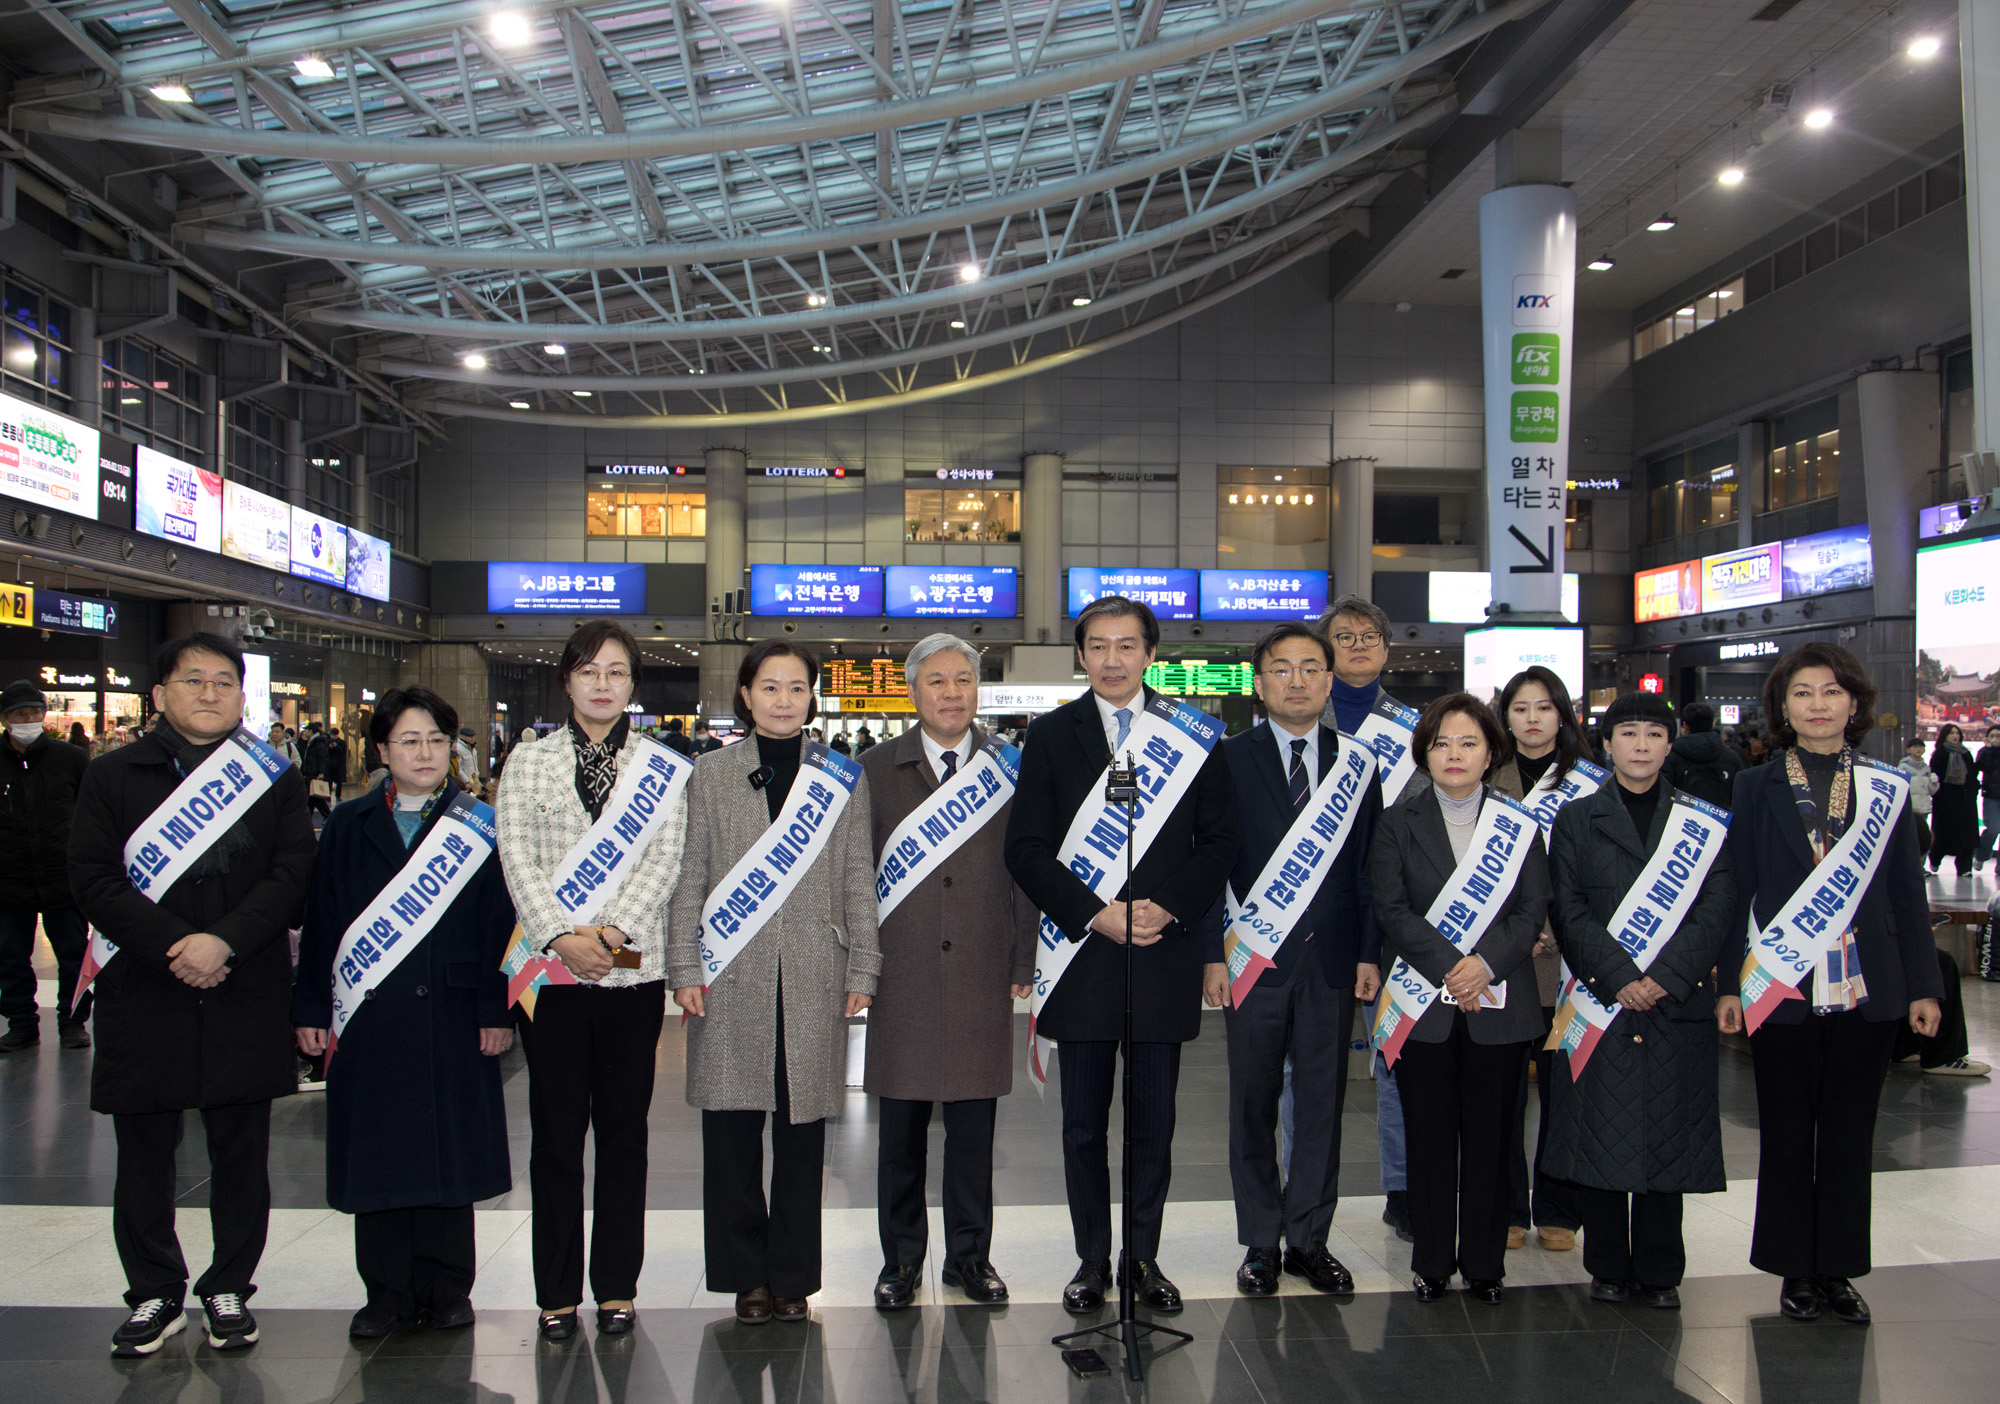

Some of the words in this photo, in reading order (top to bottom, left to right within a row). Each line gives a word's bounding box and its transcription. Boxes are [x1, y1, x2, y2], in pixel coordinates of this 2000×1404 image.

[1516, 294, 1558, 308] KTX
[1521, 366, 1550, 377] 새마을
[1515, 425, 1556, 434] Mugunghwa
[1516, 406, 1556, 422] 무궁화
[167, 471, 198, 501] 국가대표
[605, 464, 670, 476] LOTTERIA
[765, 466, 829, 478] LOTTERIA
[949, 468, 994, 481] 상하이짬뽕
[103, 480, 127, 502] 09:14
[1503, 487, 1542, 508] 타는
[1547, 487, 1561, 510] 곳
[536, 575, 616, 592] JB금융그룹
[797, 571, 838, 582] 서울에서도
[928, 573, 974, 583] 수도권에서도
[1100, 575, 1124, 585] 당신의
[1240, 579, 1302, 592] JB자산운용
[1711, 554, 1772, 590] 전주기전대학
[16, 596, 24, 615] 2
[60, 599, 73, 615] 타는
[74, 601, 81, 617] 곳
[795, 584, 860, 602] 전북은행
[928, 585, 994, 603] 광주은행
[1231, 597, 1311, 610] JB인베스트먼트
[1944, 586, 1985, 605] K문화수도
[41, 612, 60, 624] Platforms
[1519, 654, 1558, 663] K문화수도
[270, 682, 283, 693] TOUS
[287, 683, 301, 696] JOURS
[995, 695, 1013, 705] 덮밥
[1026, 695, 1044, 705] 강정
[1156, 699, 1214, 740] 조국혁신당
[1725, 707, 1736, 719] 약
[236, 732, 281, 775] 조국혁신당
[810, 752, 855, 784] 조국혁신당
[157, 757, 254, 852] 혁신으로
[613, 753, 677, 845] 혁신으로
[917, 766, 1002, 848] 혁신으로
[1310, 750, 1367, 843] 혁신으로
[1679, 794, 1729, 820] 조국혁신당
[452, 805, 497, 839] 조국혁신당
[764, 780, 835, 876] 혁신으로
[1849, 777, 1897, 871] 혁신으로
[127, 841, 172, 892] 희망
[555, 837, 625, 913] 희망찬
[875, 835, 928, 904] 희망찬
[1263, 837, 1325, 911] 희망찬
[1461, 813, 1523, 905] 혁신으로
[1645, 817, 1711, 911] 혁신으로
[389, 832, 474, 927] 혁신으로
[708, 867, 778, 940] 희망찬
[1791, 864, 1860, 939] 희망찬
[1239, 900, 1284, 945] 2026
[338, 916, 403, 990] 희망찬
[1227, 945, 1252, 979] 福
[1760, 925, 1811, 973] 2026
[1390, 960, 1437, 1006] 2026
[1740, 968, 1772, 1004] 福
[1380, 1006, 1402, 1038] 福
[1563, 1018, 1588, 1051] 福
